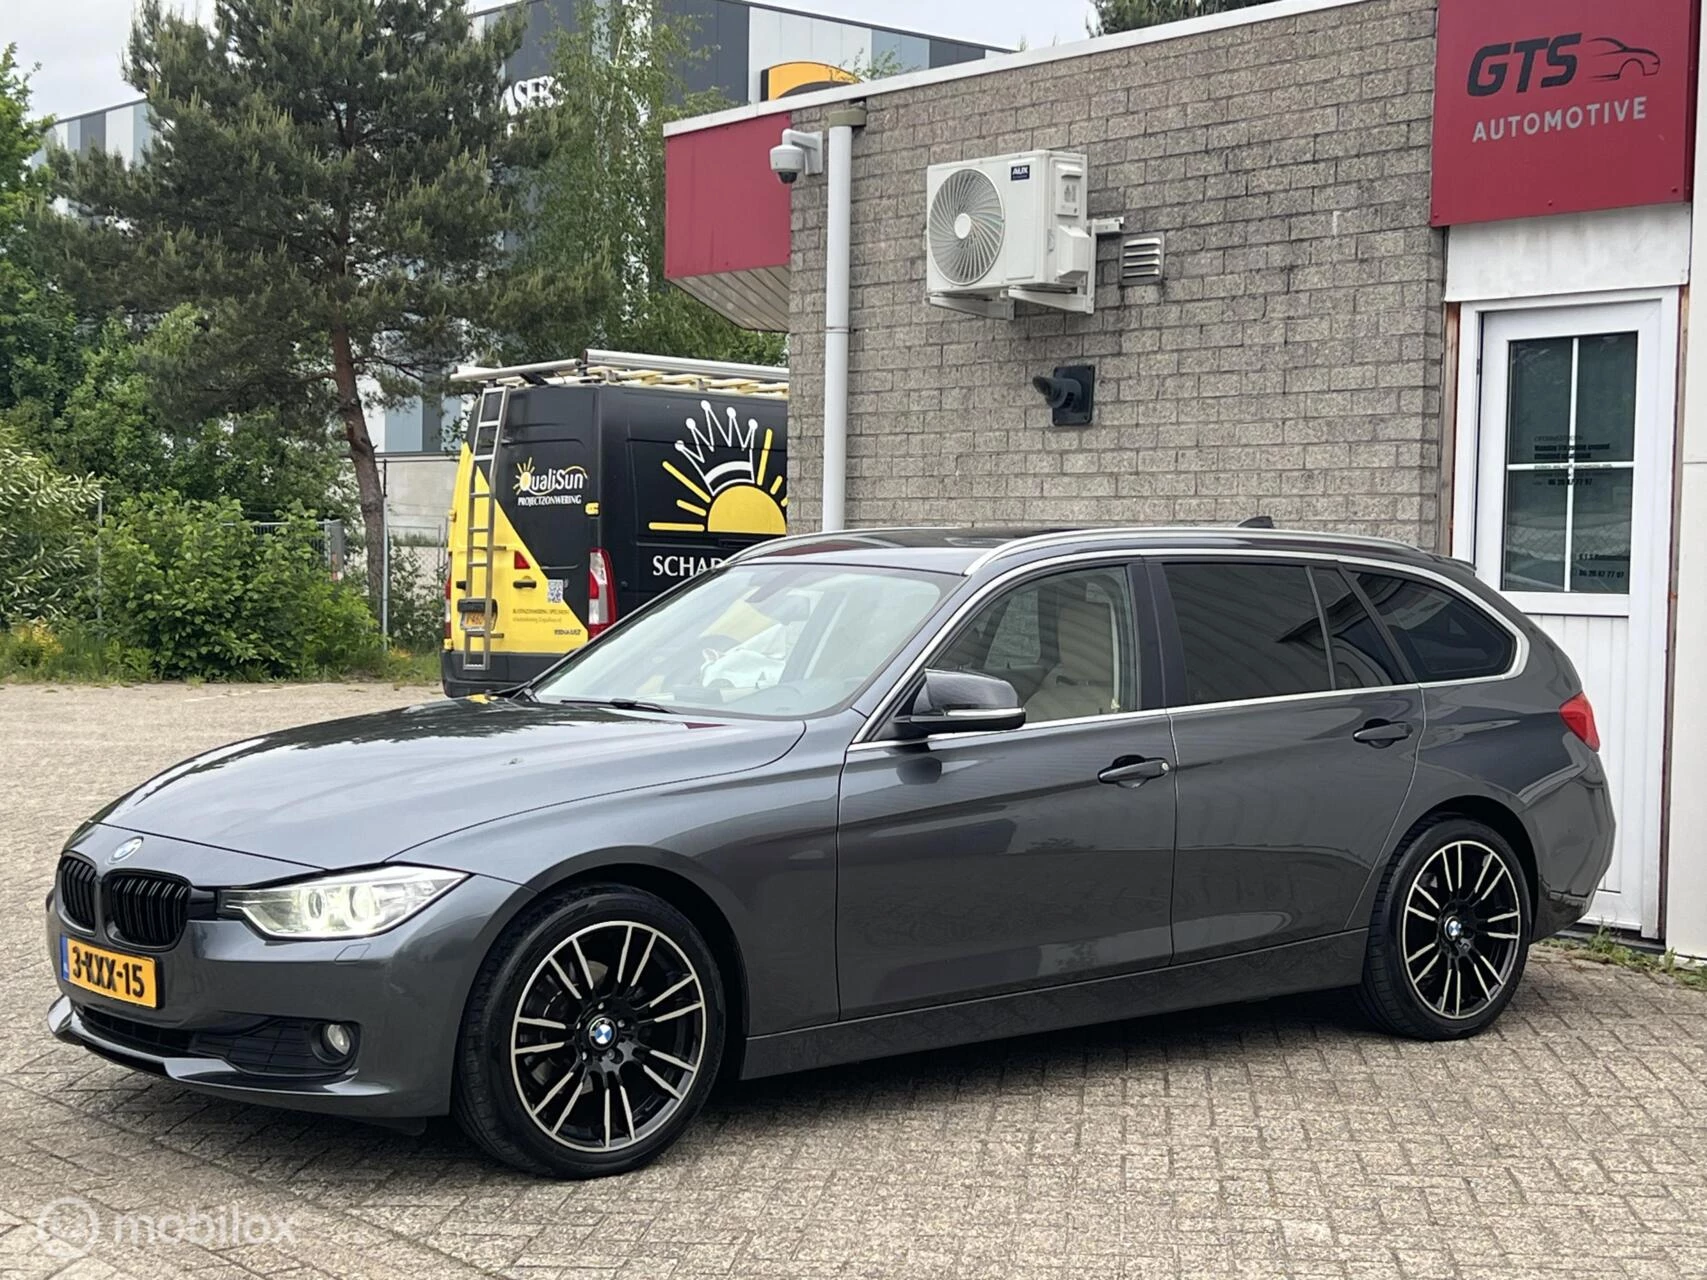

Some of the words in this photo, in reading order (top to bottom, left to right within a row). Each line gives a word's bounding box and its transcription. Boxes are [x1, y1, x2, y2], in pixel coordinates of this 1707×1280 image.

[1467, 33, 1582, 97] GTS
[1472, 96, 1647, 143] AUTOMOTIVE
[519, 467, 585, 495] QualiSun
